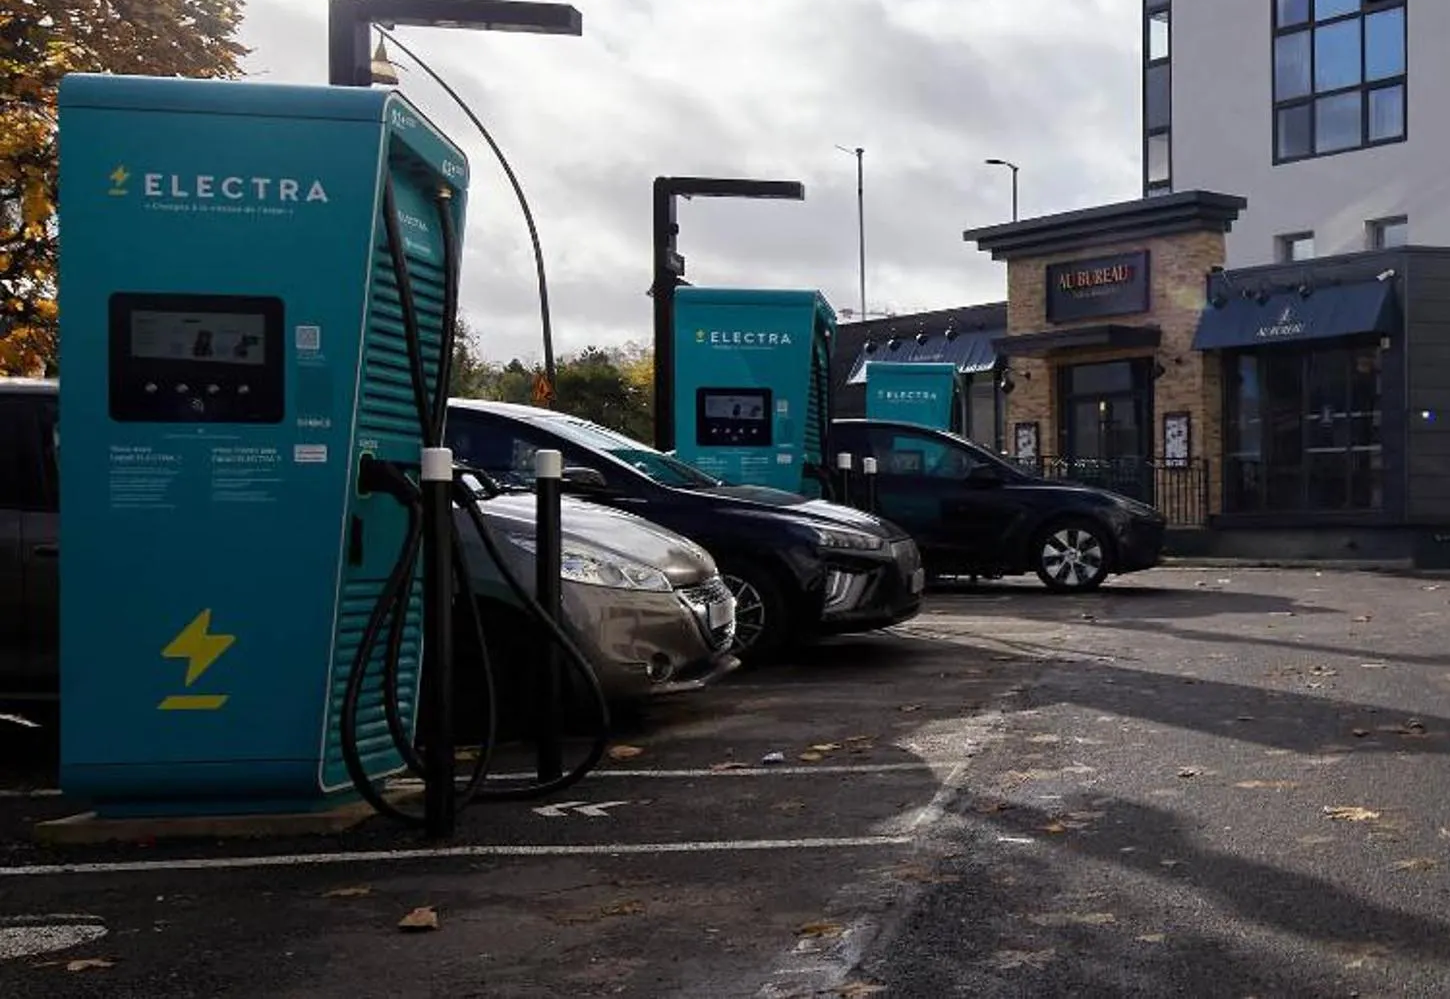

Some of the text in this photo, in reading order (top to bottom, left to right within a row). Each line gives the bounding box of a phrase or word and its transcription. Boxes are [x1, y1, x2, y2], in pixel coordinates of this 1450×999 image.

[143, 172, 329, 204] ELECTRA
[1077, 263, 1129, 287] BUREAU
[709, 330, 792, 345] ELECTRA
